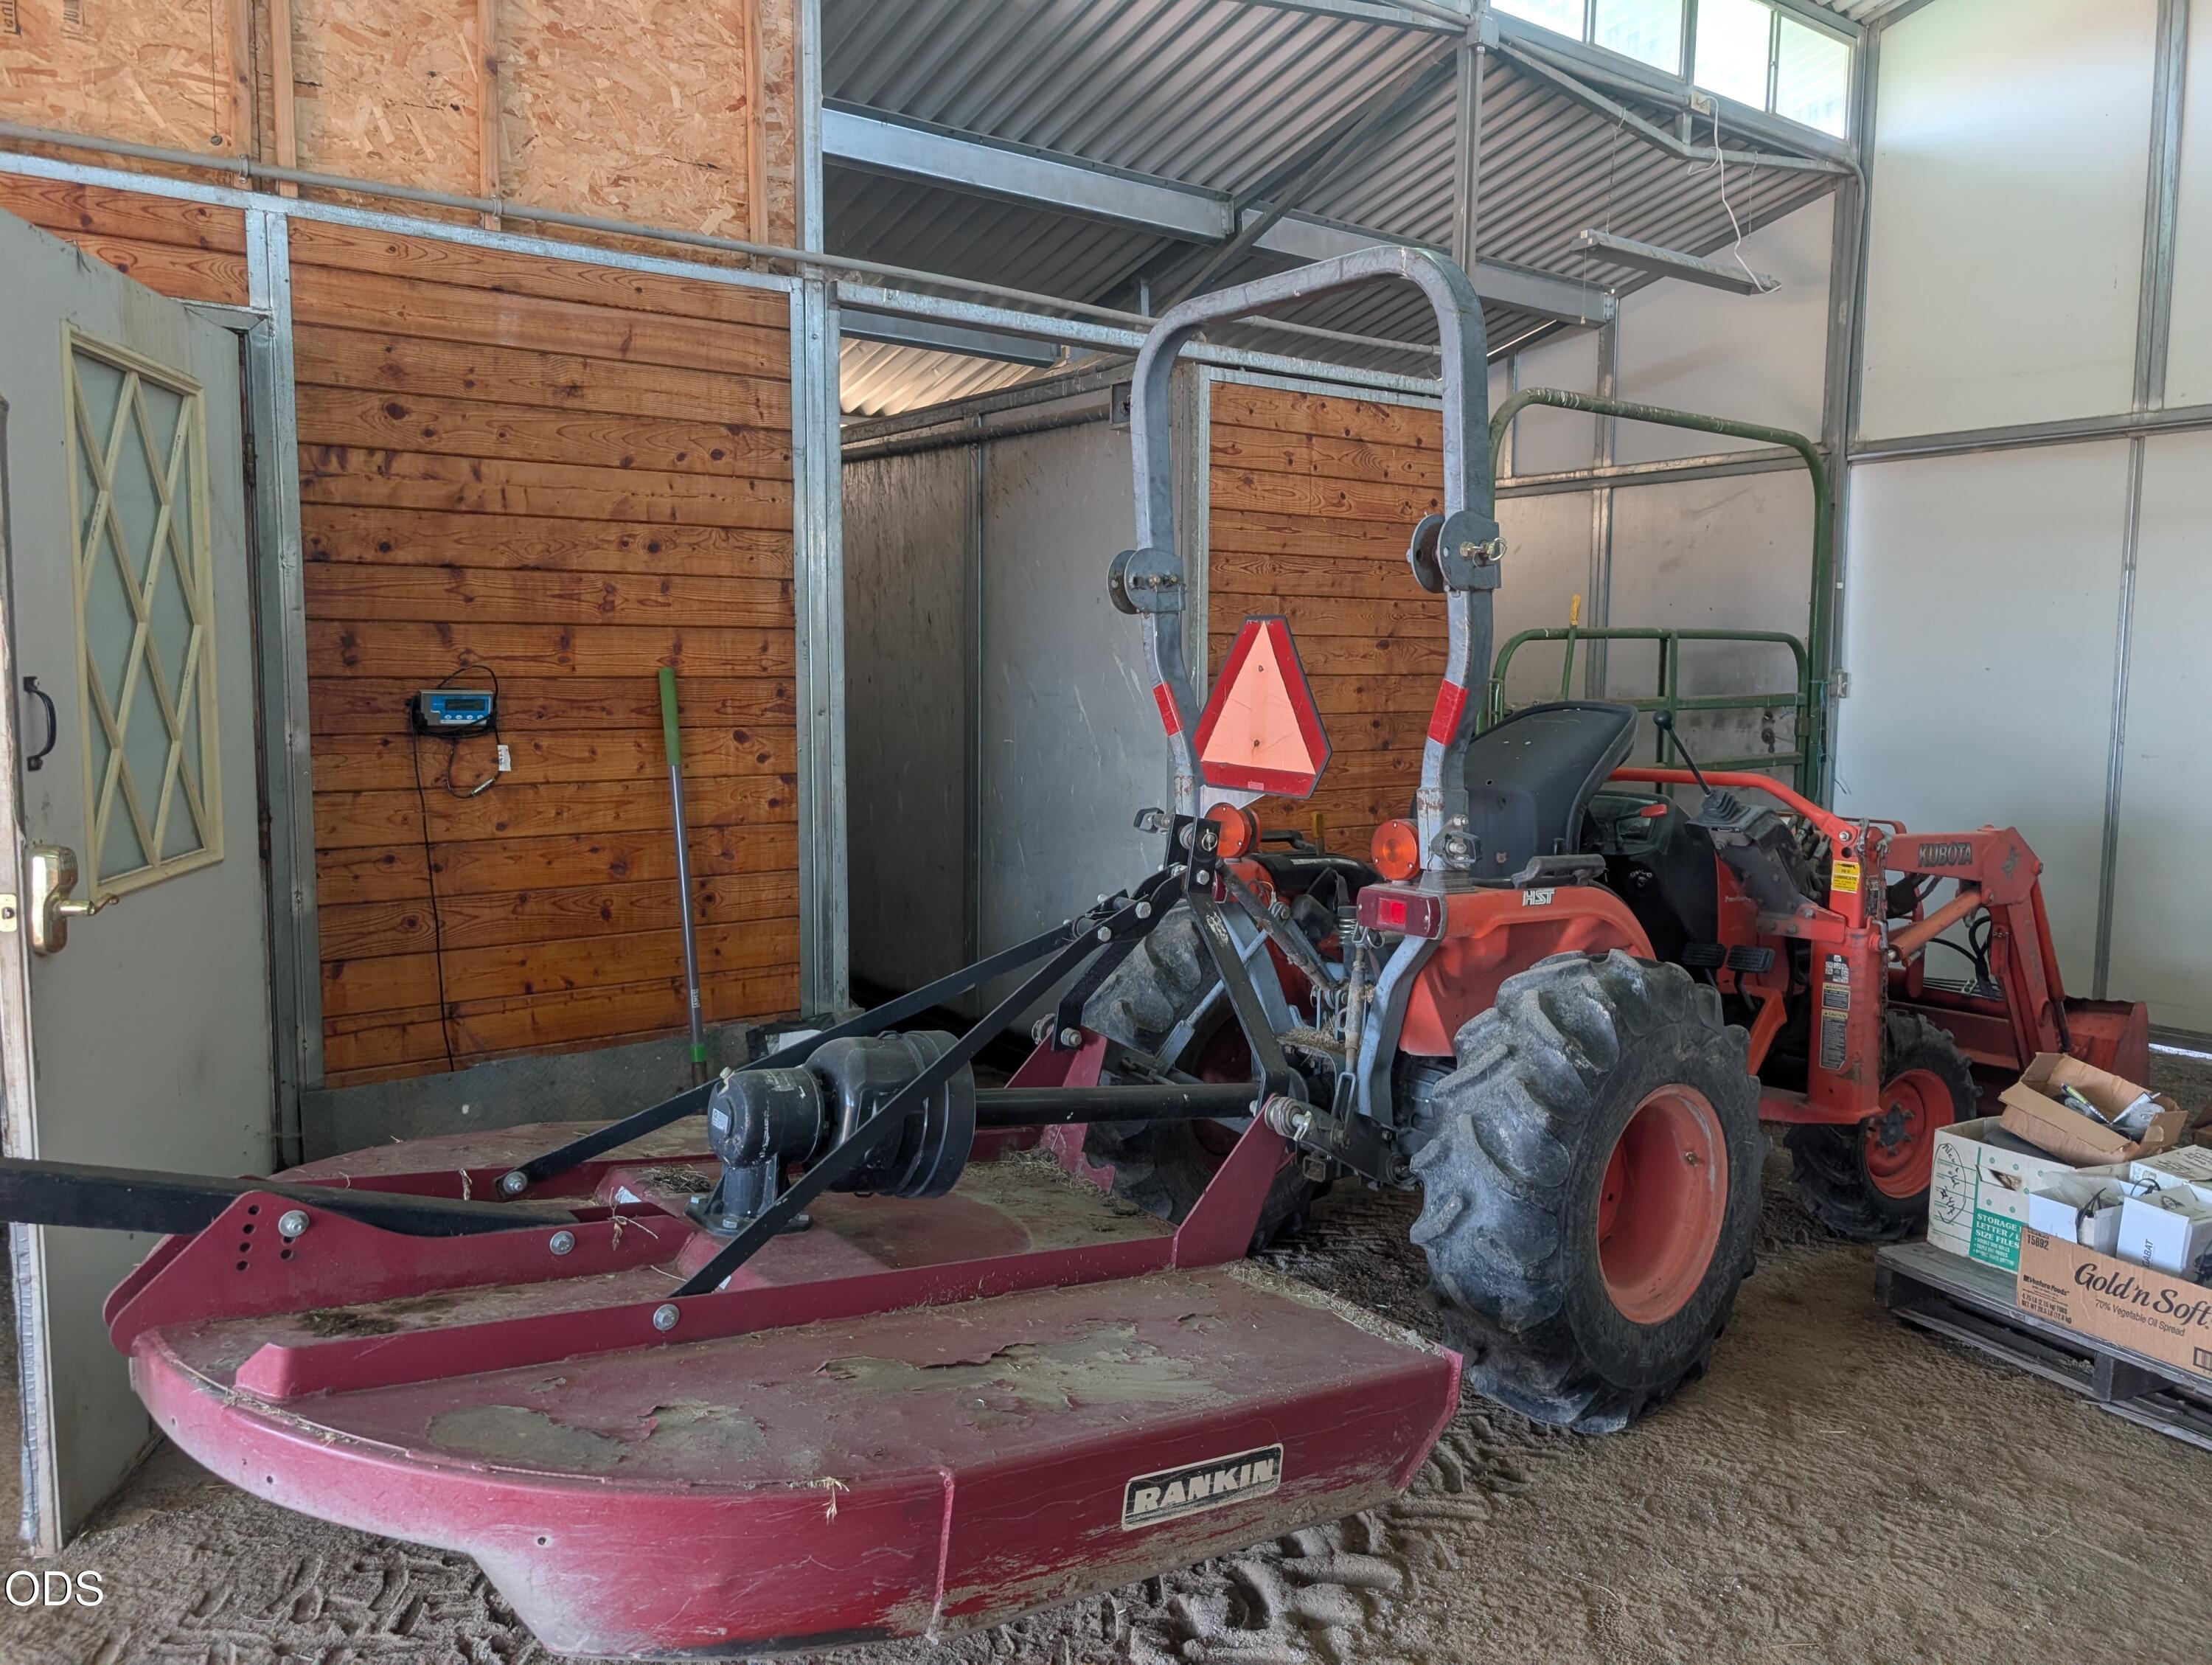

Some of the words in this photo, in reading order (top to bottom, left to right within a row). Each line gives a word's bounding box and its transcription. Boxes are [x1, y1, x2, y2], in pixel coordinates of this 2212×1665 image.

[1919, 843, 1972, 867] KUBOTA
[1523, 888, 1556, 906] HST
[1975, 1220, 2007, 1237] LETTER
[1976, 1212, 2017, 1231] STORAGE
[1975, 1229, 1994, 1240] SIZE
[1995, 1235, 2020, 1248] FILES
[2142, 1239, 2154, 1268] GABAT
[2096, 1299, 2111, 1311] 70%
[2112, 1304, 2146, 1323] Vegetable
[2147, 1316, 2157, 1327] Oil
[2159, 1321, 2185, 1337] Spread
[1134, 1459, 1274, 1512] RANKIN
